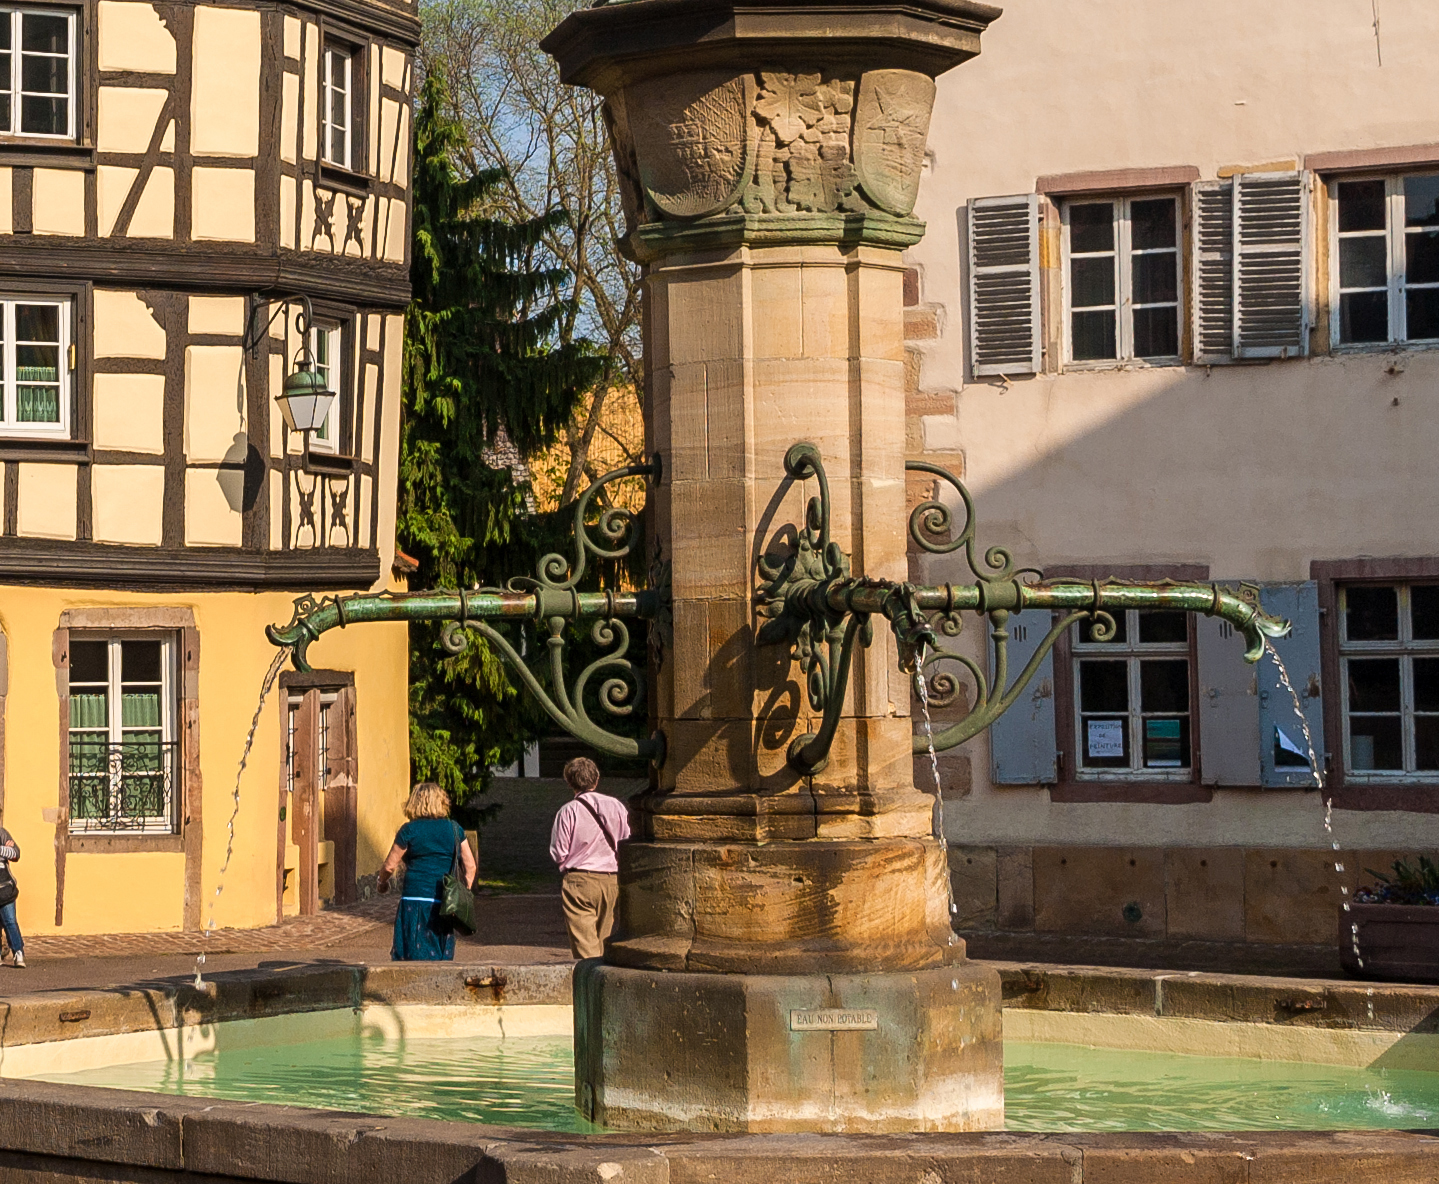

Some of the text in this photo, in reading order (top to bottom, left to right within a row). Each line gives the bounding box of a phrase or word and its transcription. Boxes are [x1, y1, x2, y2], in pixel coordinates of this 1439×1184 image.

[1089, 742, 1122, 750] PEINTURE
[797, 1014, 872, 1025] EAU NON POTABLE
